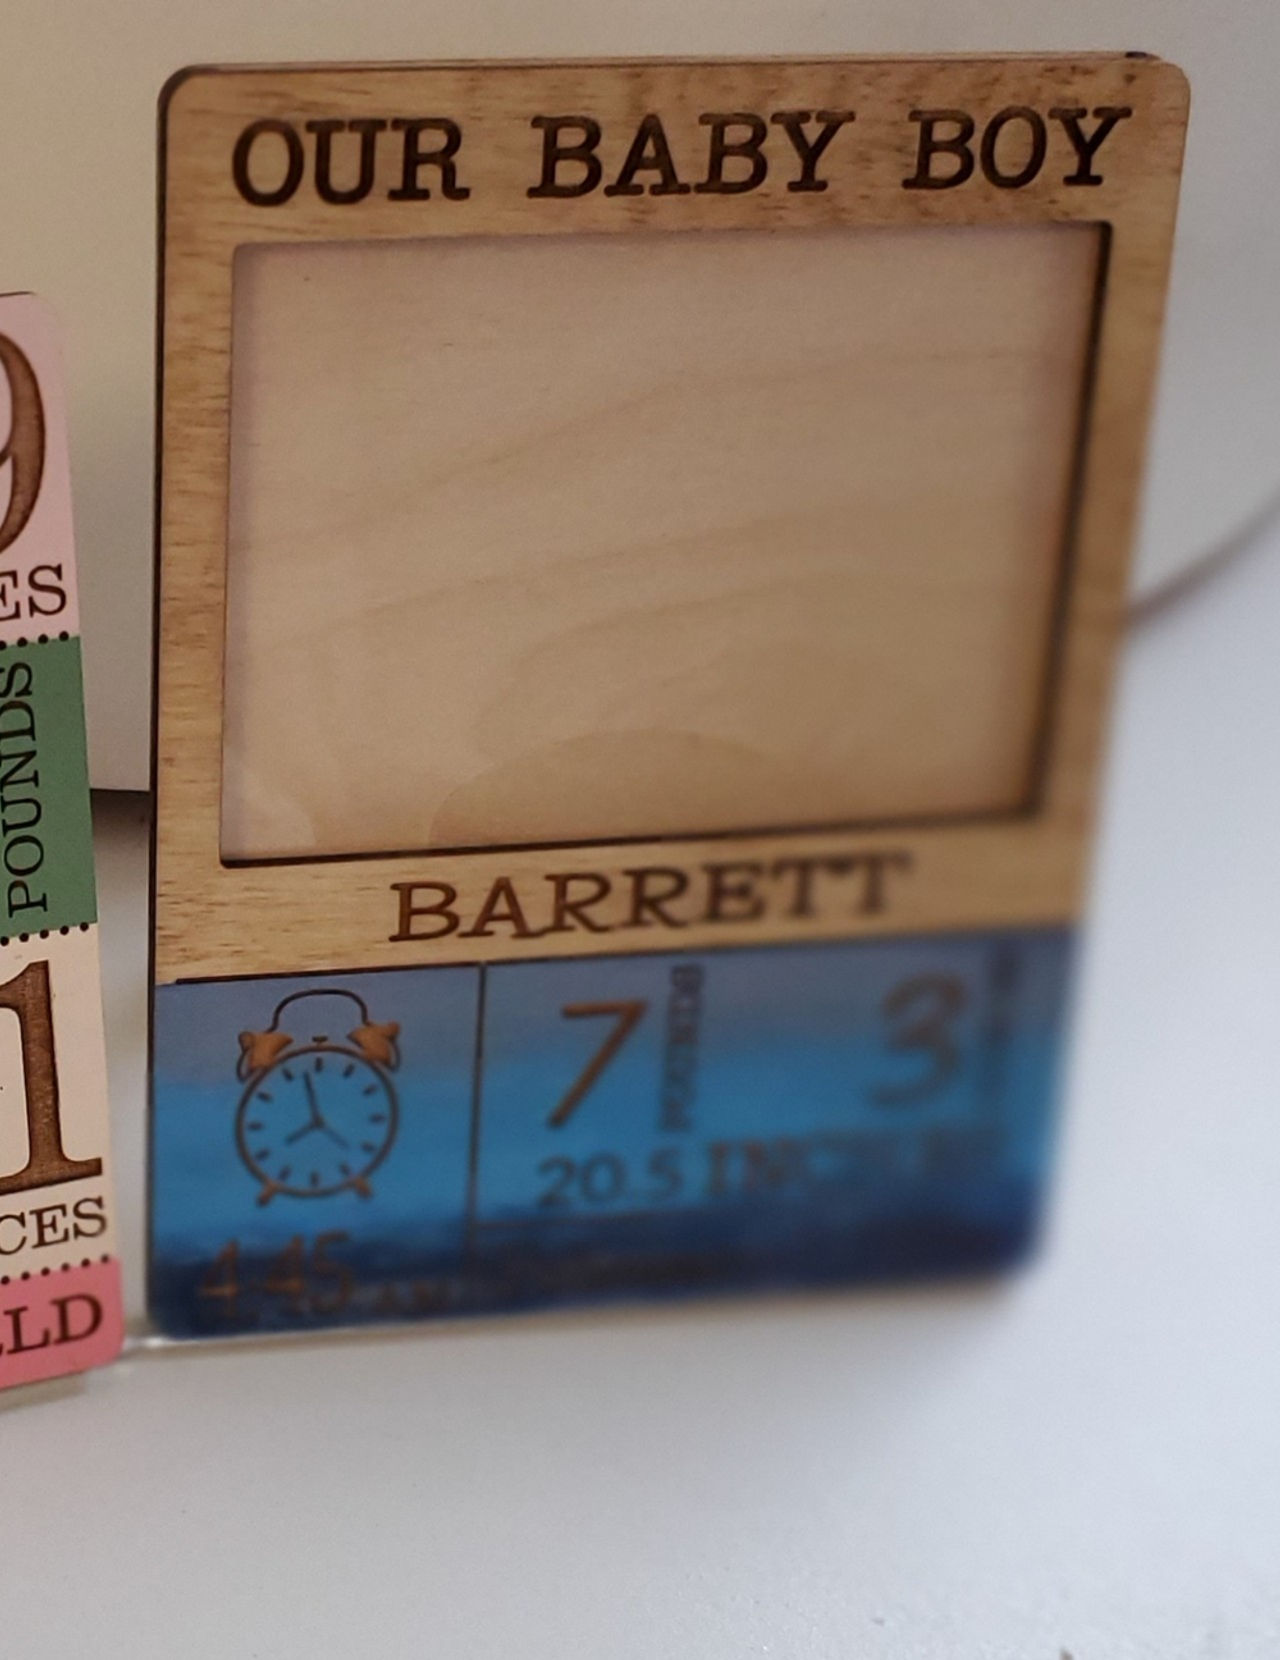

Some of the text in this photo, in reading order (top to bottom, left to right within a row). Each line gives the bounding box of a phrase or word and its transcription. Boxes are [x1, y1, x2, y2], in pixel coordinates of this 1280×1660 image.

[231, 106, 1132, 207] OUR BABY BOY
[388, 848, 912, 943] BARRETT
[546, 997, 648, 1130] 7
